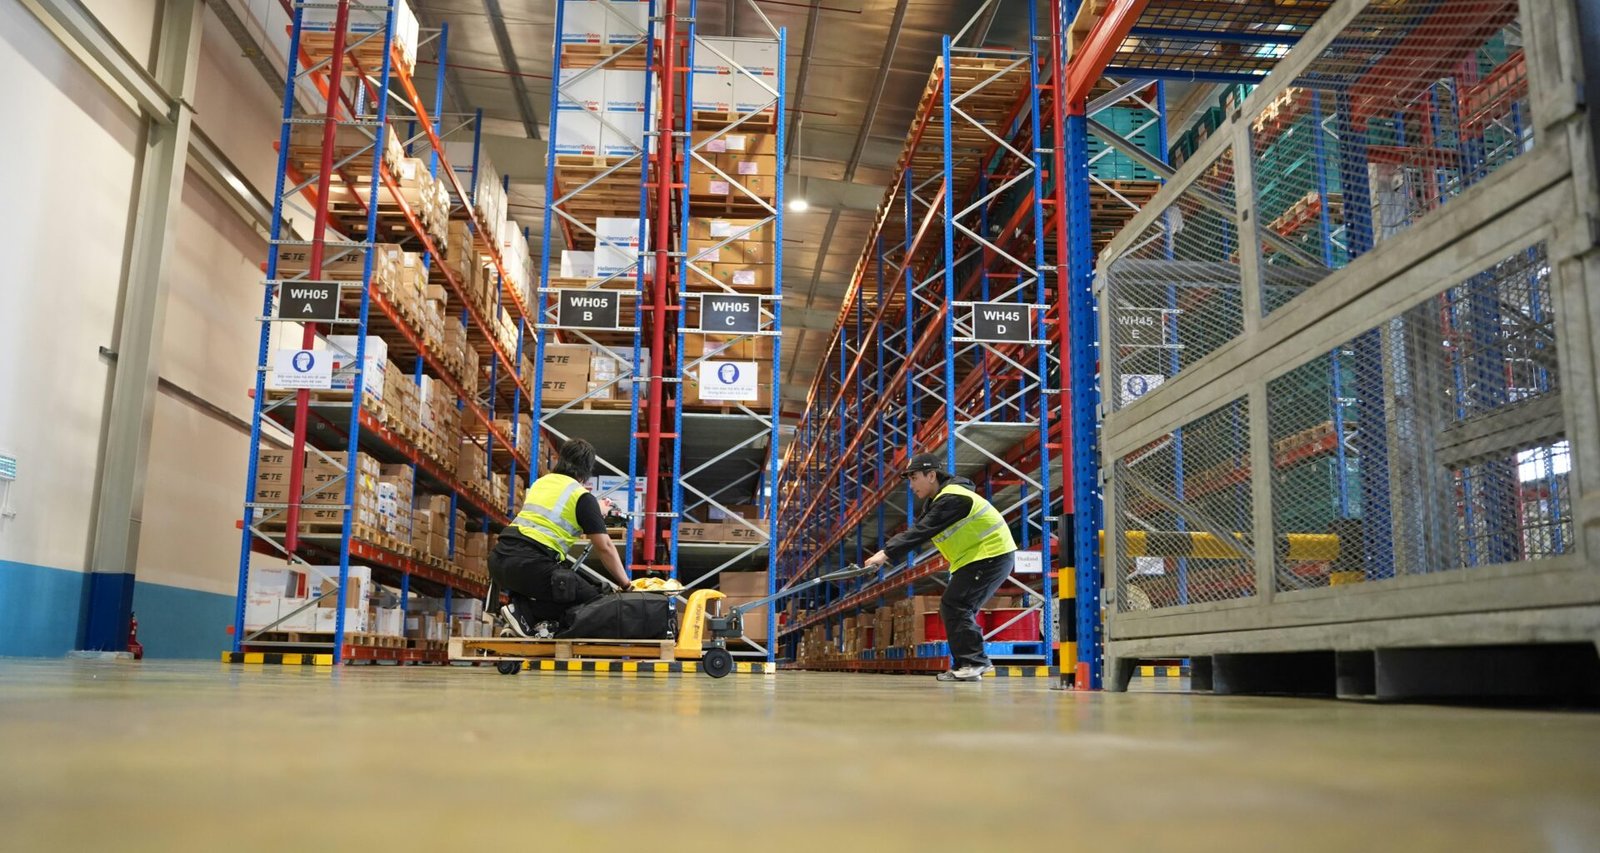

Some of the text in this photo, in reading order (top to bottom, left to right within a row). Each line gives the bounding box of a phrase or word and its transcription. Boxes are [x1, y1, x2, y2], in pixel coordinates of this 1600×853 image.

[292, 253, 305, 261] TE
[290, 288, 329, 299] WH05
[302, 302, 313, 313] A
[570, 297, 608, 308] WH05
[711, 301, 750, 312] WH05
[583, 311, 593, 321] B
[725, 315, 735, 326] C
[983, 310, 1020, 322] WH45
[1118, 315, 1153, 326] WH45
[997, 324, 1007, 335] D
[1132, 329, 1140, 339] E
[555, 355, 570, 363] TE
[552, 381, 566, 389] TE
[692, 528, 705, 536] TE
[744, 529, 756, 537] TE
